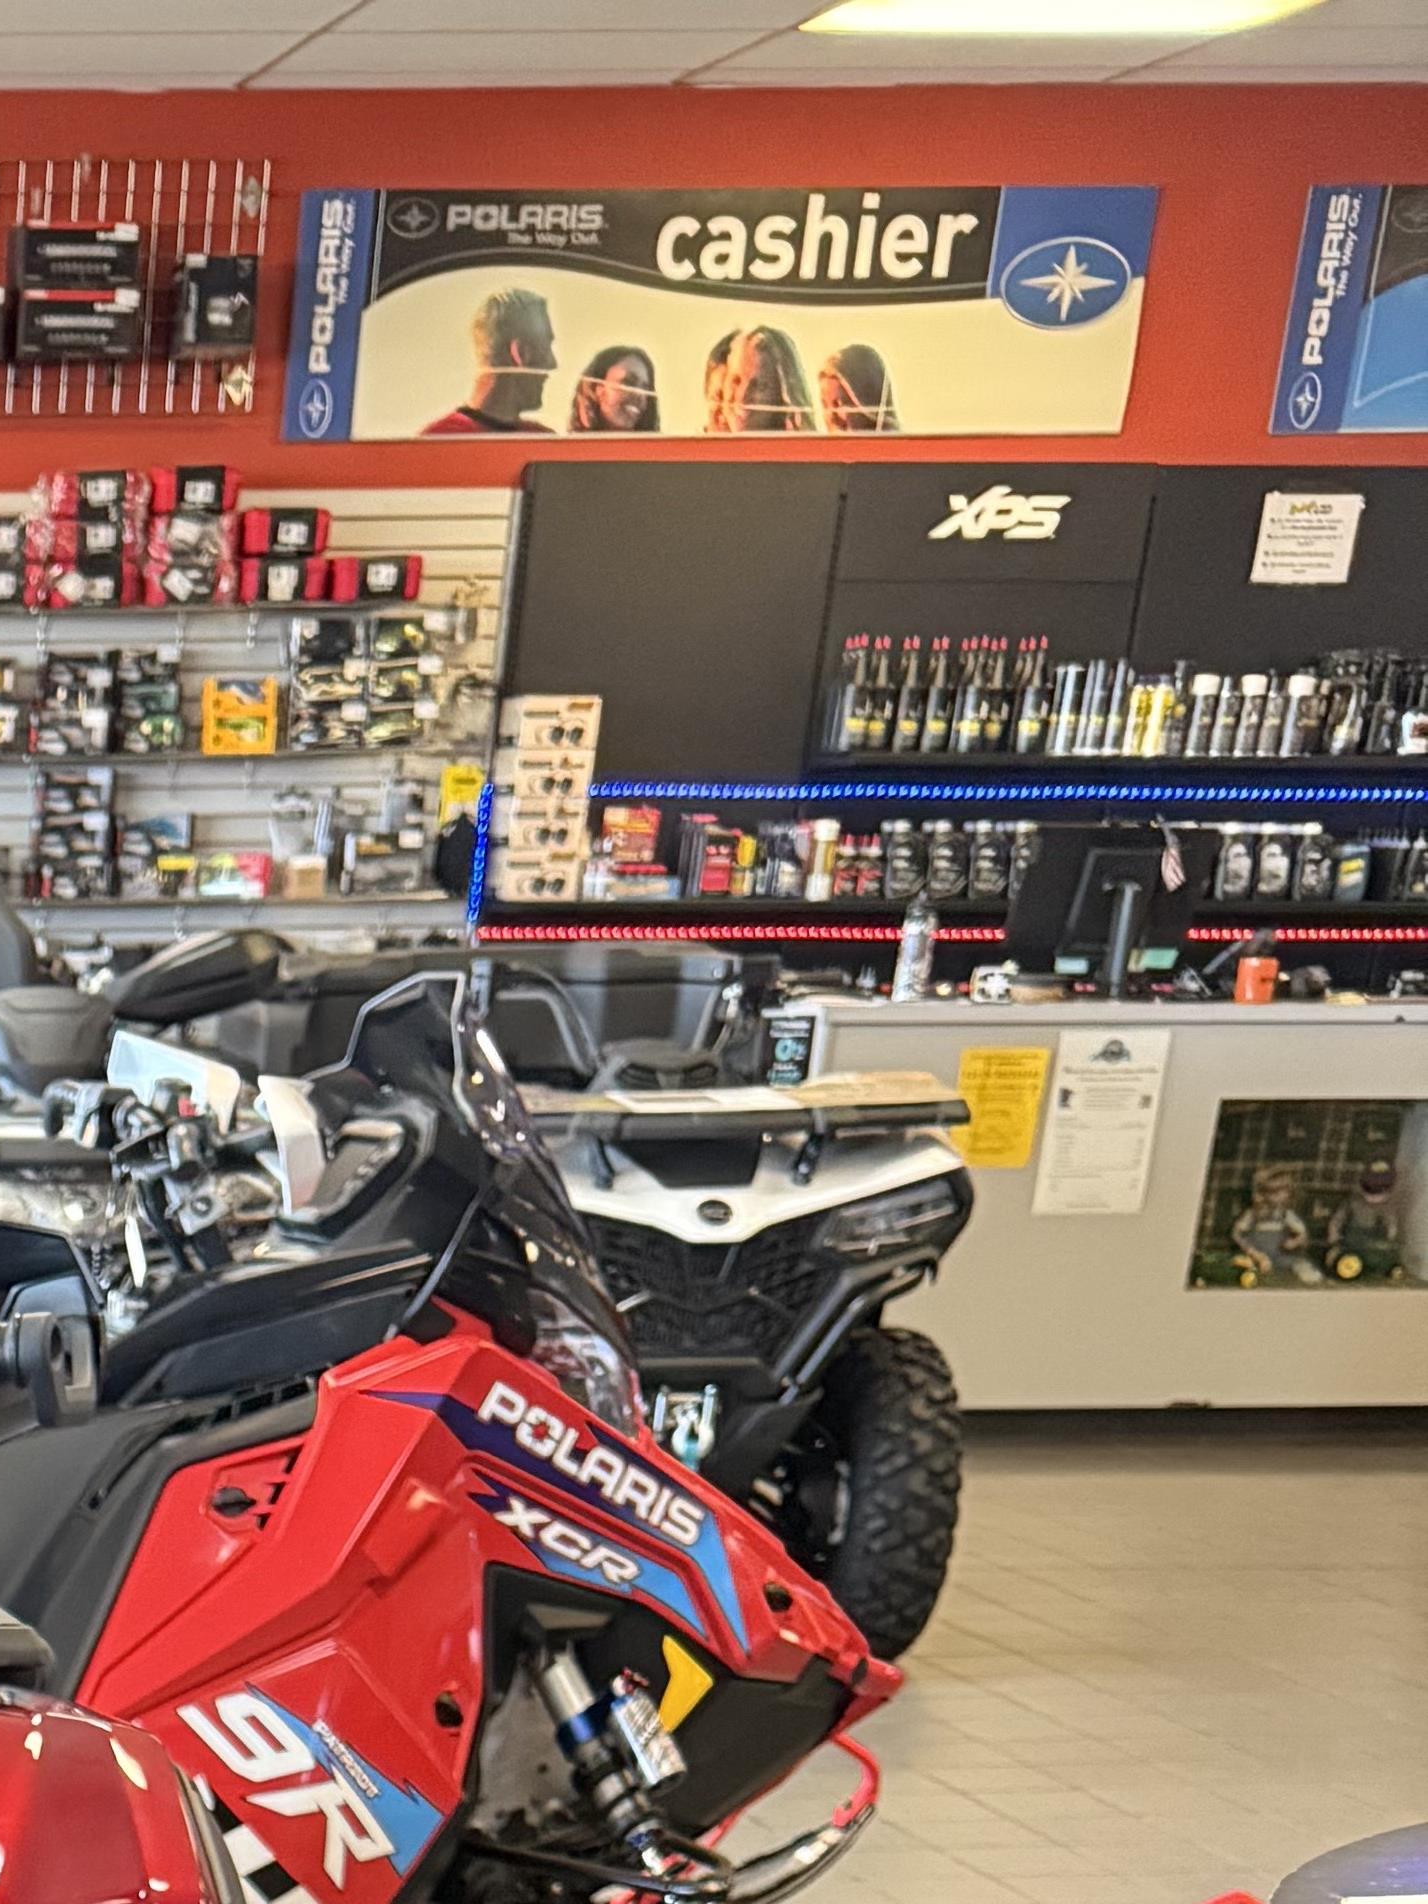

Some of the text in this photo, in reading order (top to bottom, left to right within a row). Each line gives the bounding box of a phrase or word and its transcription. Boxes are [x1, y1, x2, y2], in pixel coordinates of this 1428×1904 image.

[447, 203, 604, 231] POLARIS
[507, 232, 532, 245] The
[535, 232, 568, 249] Way
[655, 193, 979, 284] cashier
[308, 199, 344, 374] POLARIS
[1302, 194, 1350, 365] POLARIS
[928, 485, 1072, 539] XPS
[478, 1381, 707, 1547] POLARIS
[494, 1497, 642, 1586] XCR
